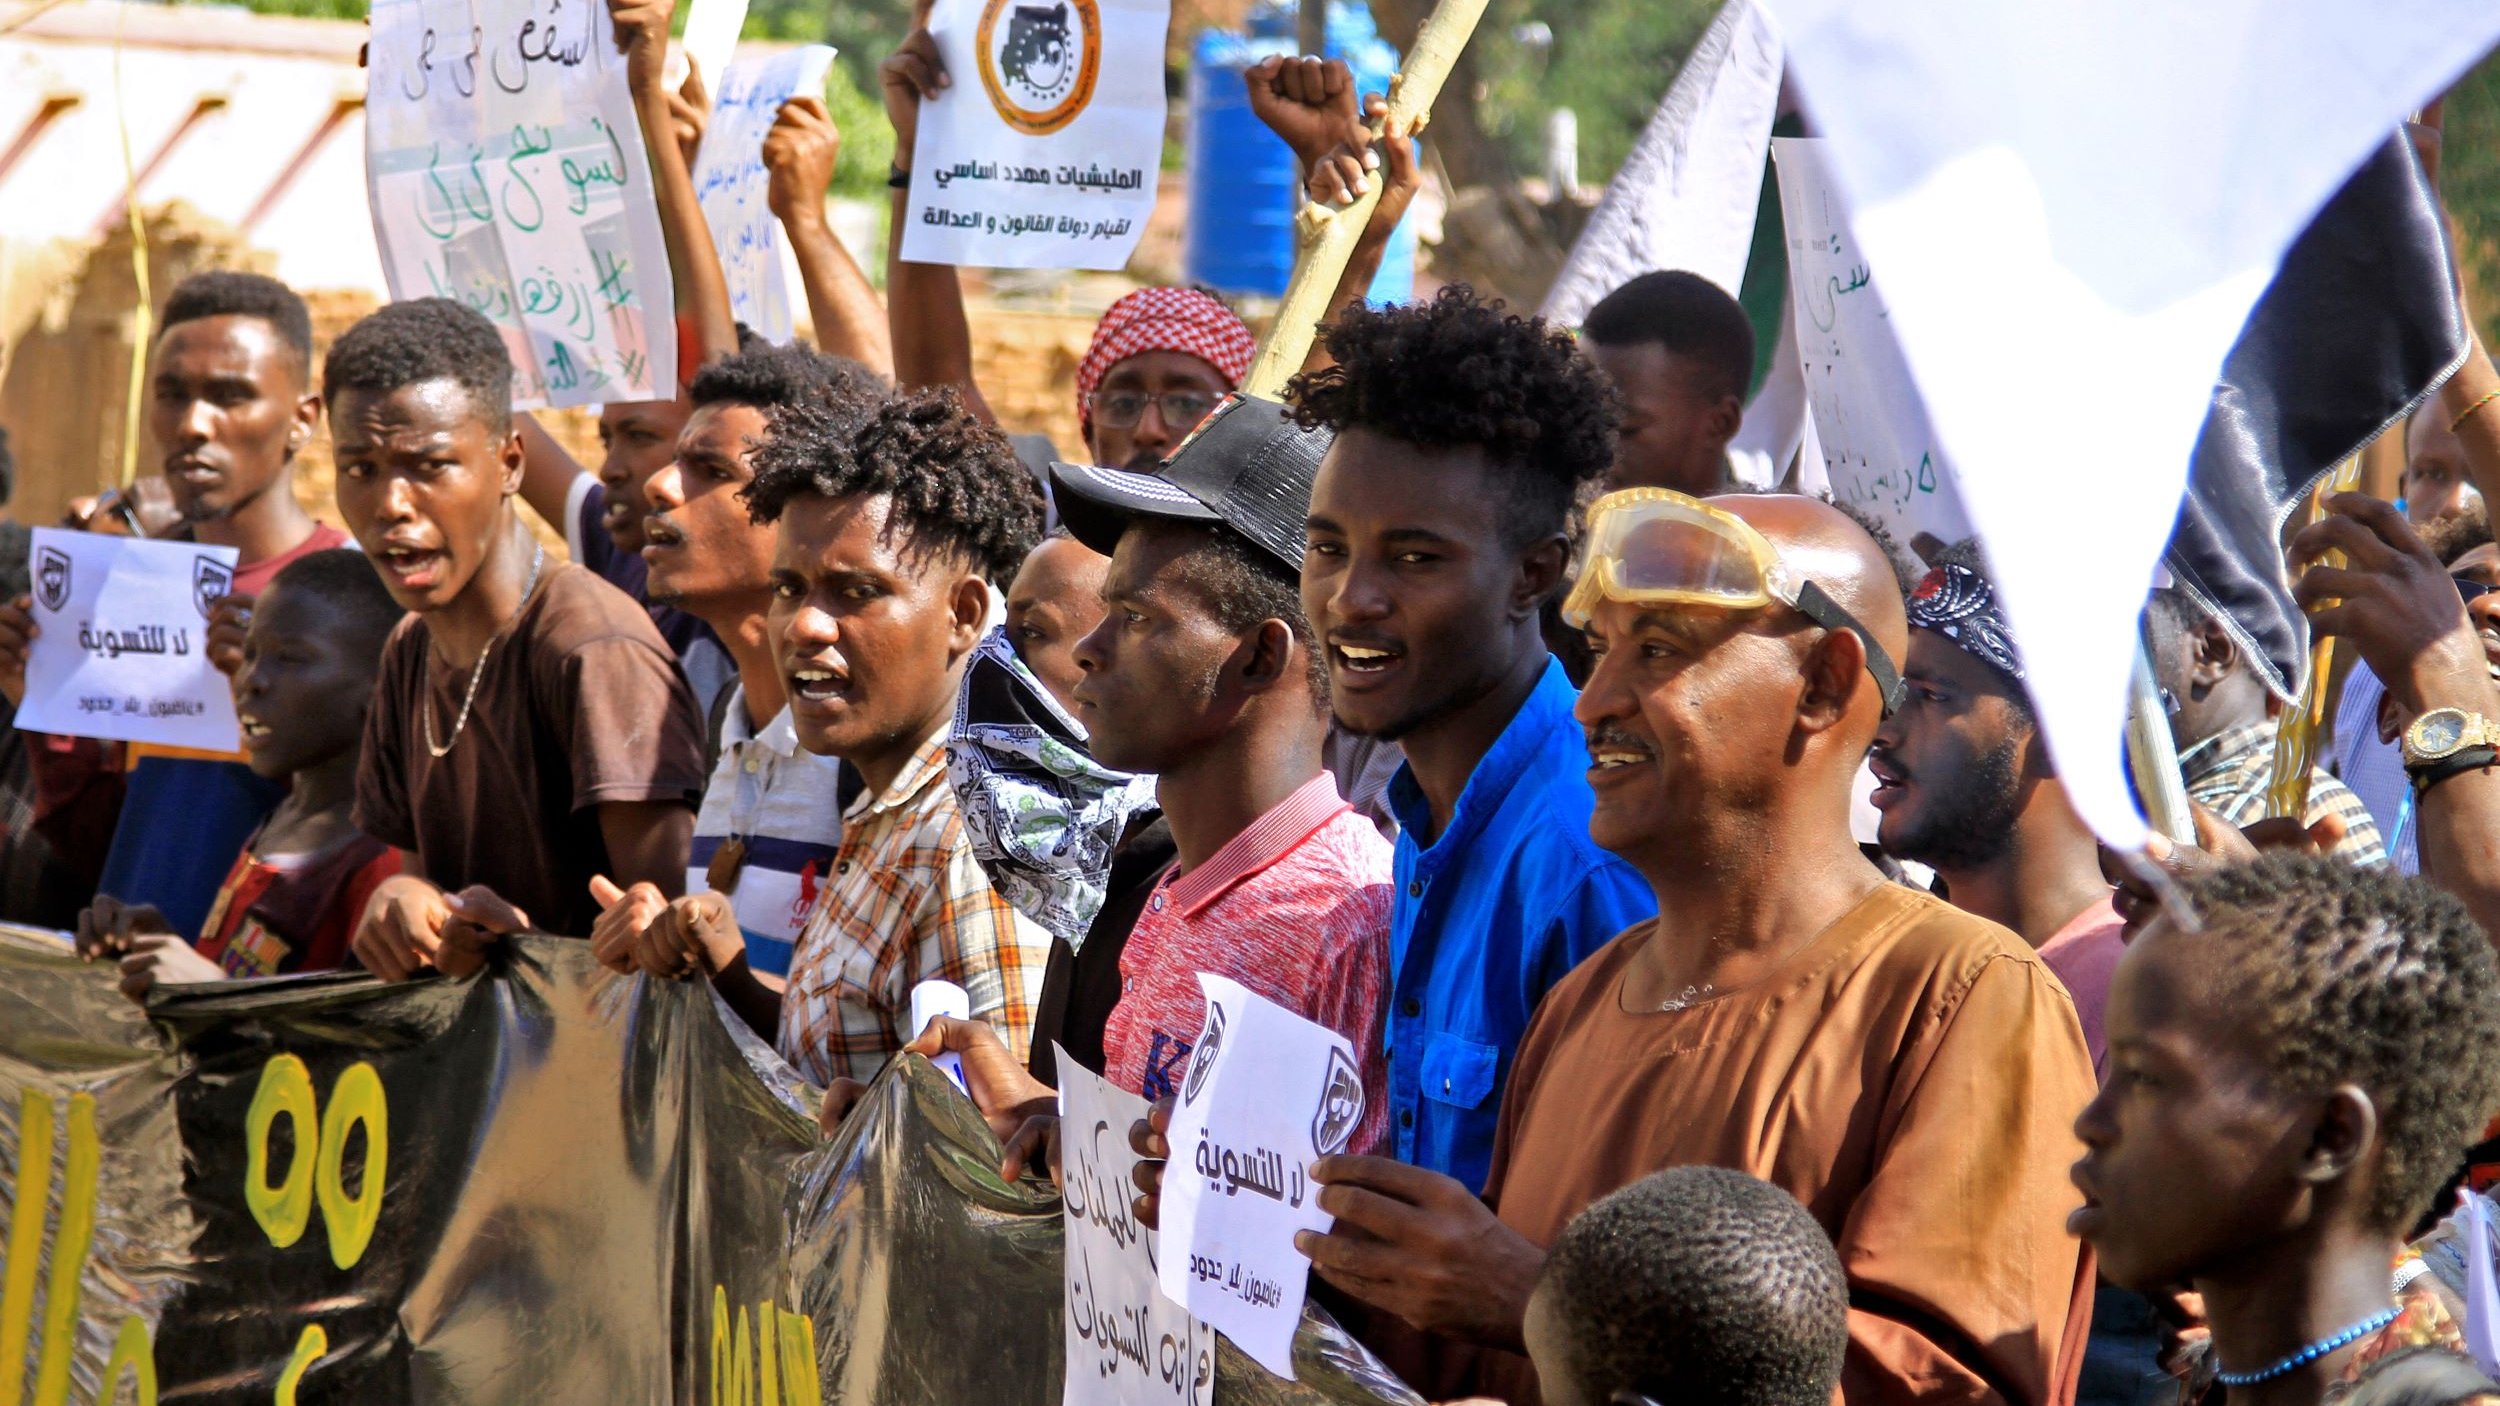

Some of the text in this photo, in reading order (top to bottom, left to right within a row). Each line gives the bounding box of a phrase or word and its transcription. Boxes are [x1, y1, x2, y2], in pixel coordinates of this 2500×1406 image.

[1004, 166, 1051, 186] مهدد
[1057, 163, 1142, 192] المليشيات
[923, 206, 982, 229] العدالة
[1001, 213, 1055, 236] القانون
[1058, 215, 1089, 238] دولة
[1092, 217, 1131, 240] لقيام
[78, 620, 189, 658] لا للتسوية
[1196, 1126, 1305, 1209] لا للتسوية
